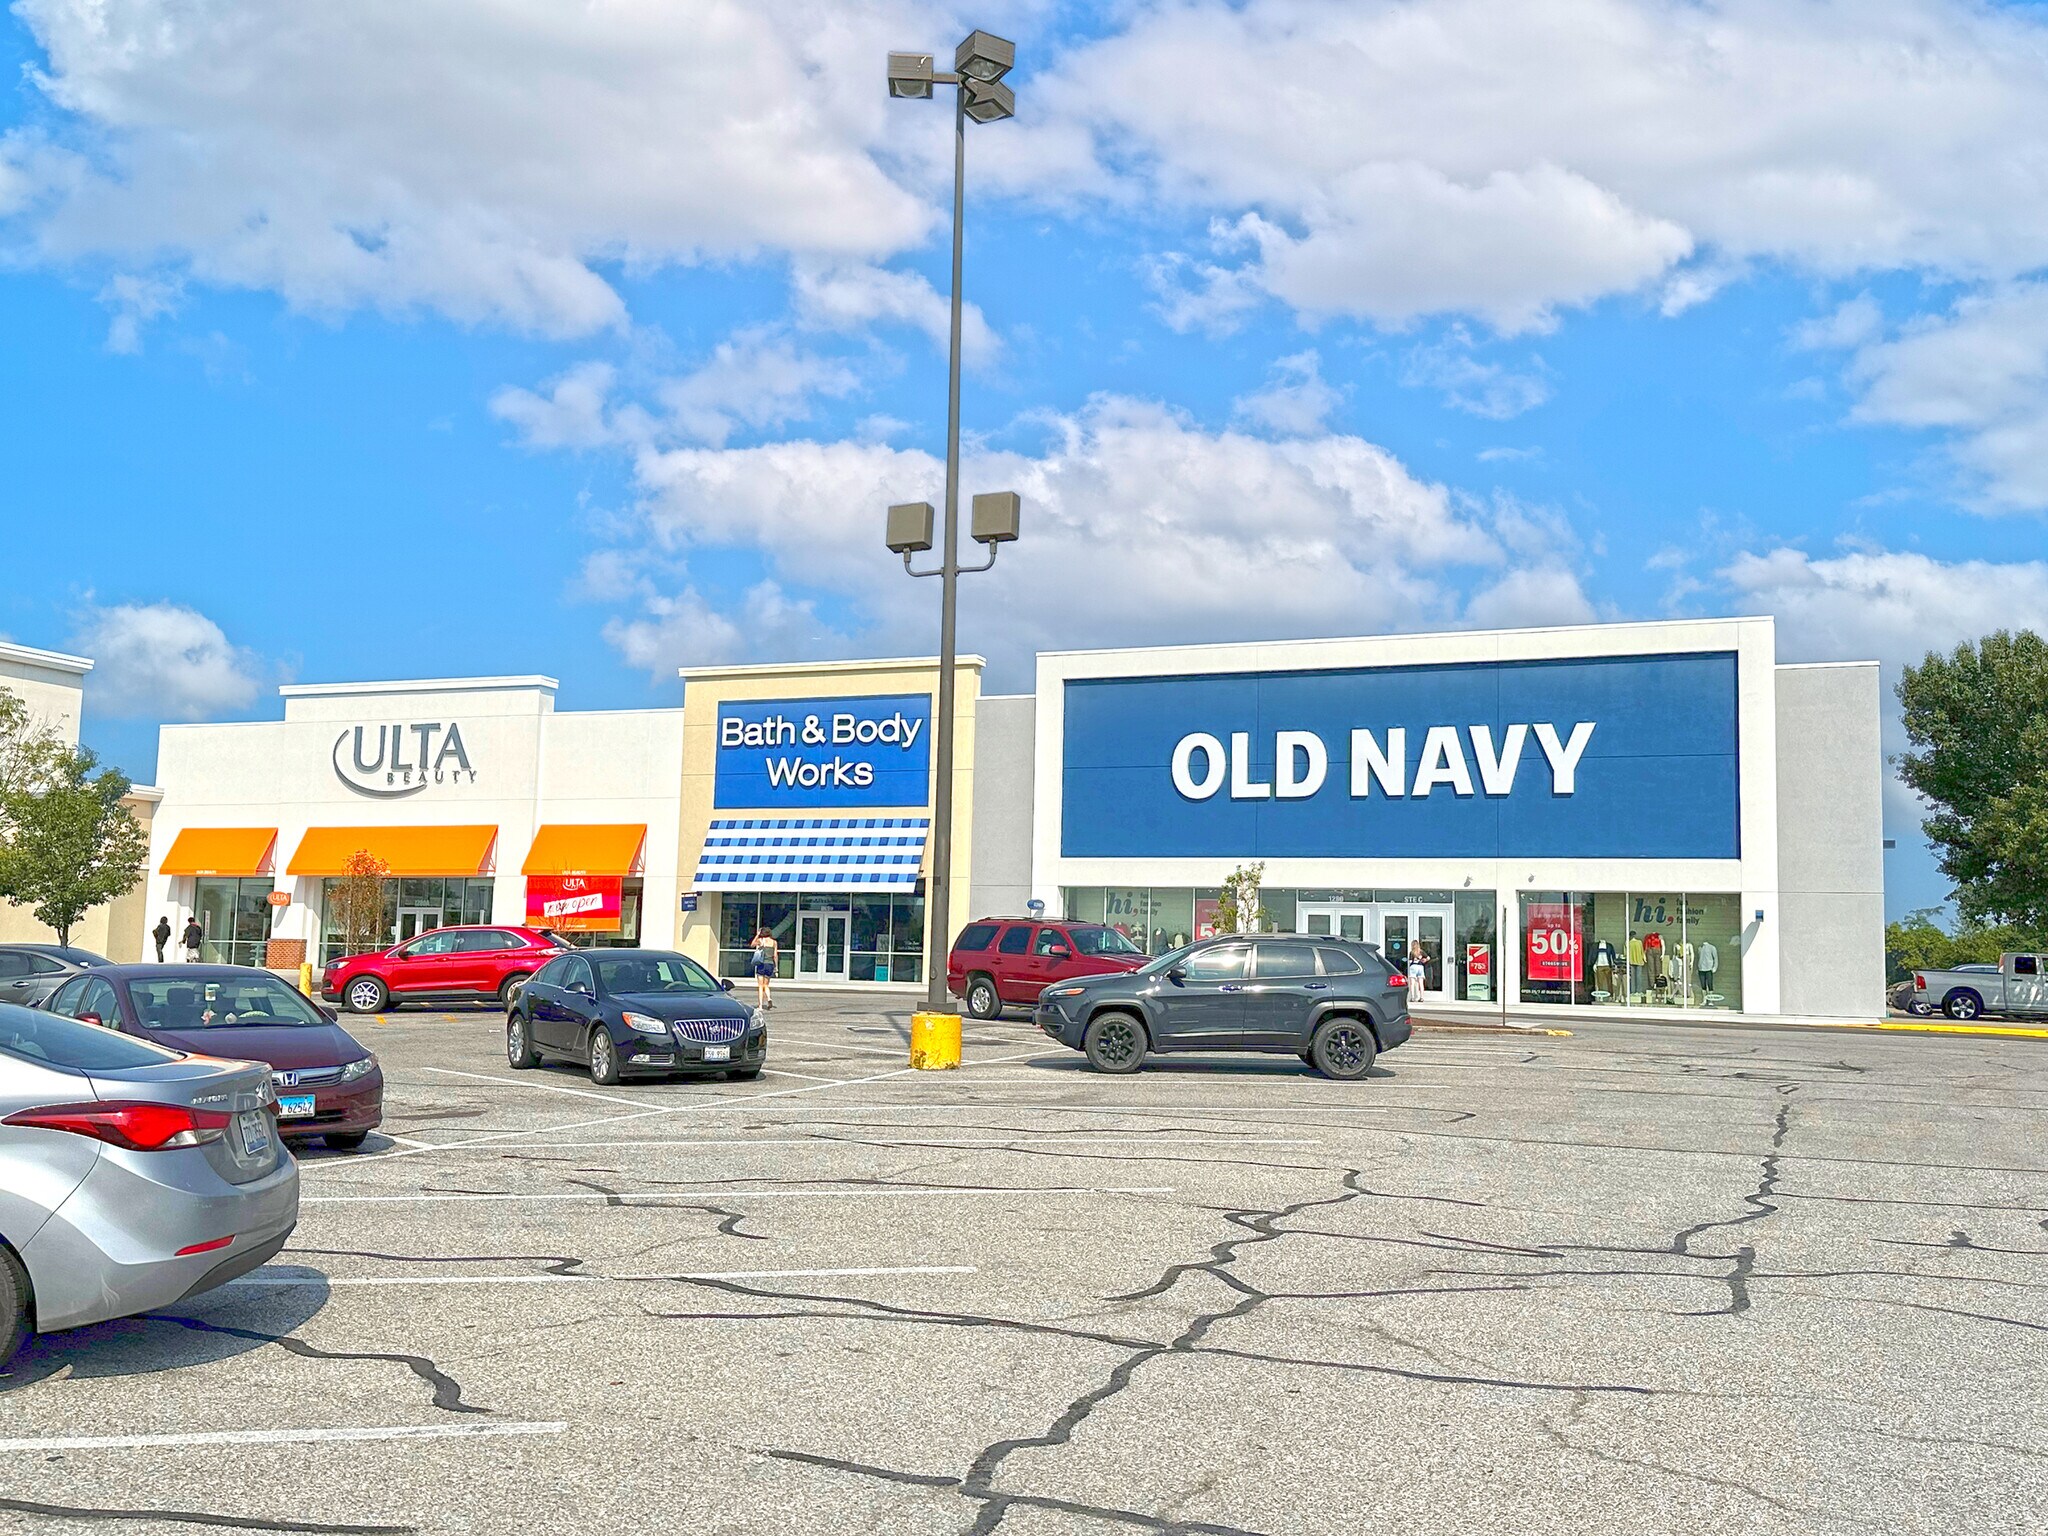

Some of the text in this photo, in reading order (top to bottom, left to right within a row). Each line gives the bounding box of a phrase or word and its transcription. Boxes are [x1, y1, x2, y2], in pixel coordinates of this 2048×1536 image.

[721, 712, 923, 748] Bath & Body
[353, 722, 472, 774] ULTA
[1171, 722, 1597, 800] OLD NAVY
[387, 770, 477, 785] BEAUTY
[765, 756, 874, 787] Works
[564, 878, 586, 889] ULTA
[271, 892, 288, 901] ULTA
[571, 896, 599, 912] open
[287, 1101, 313, 1114] 62542
